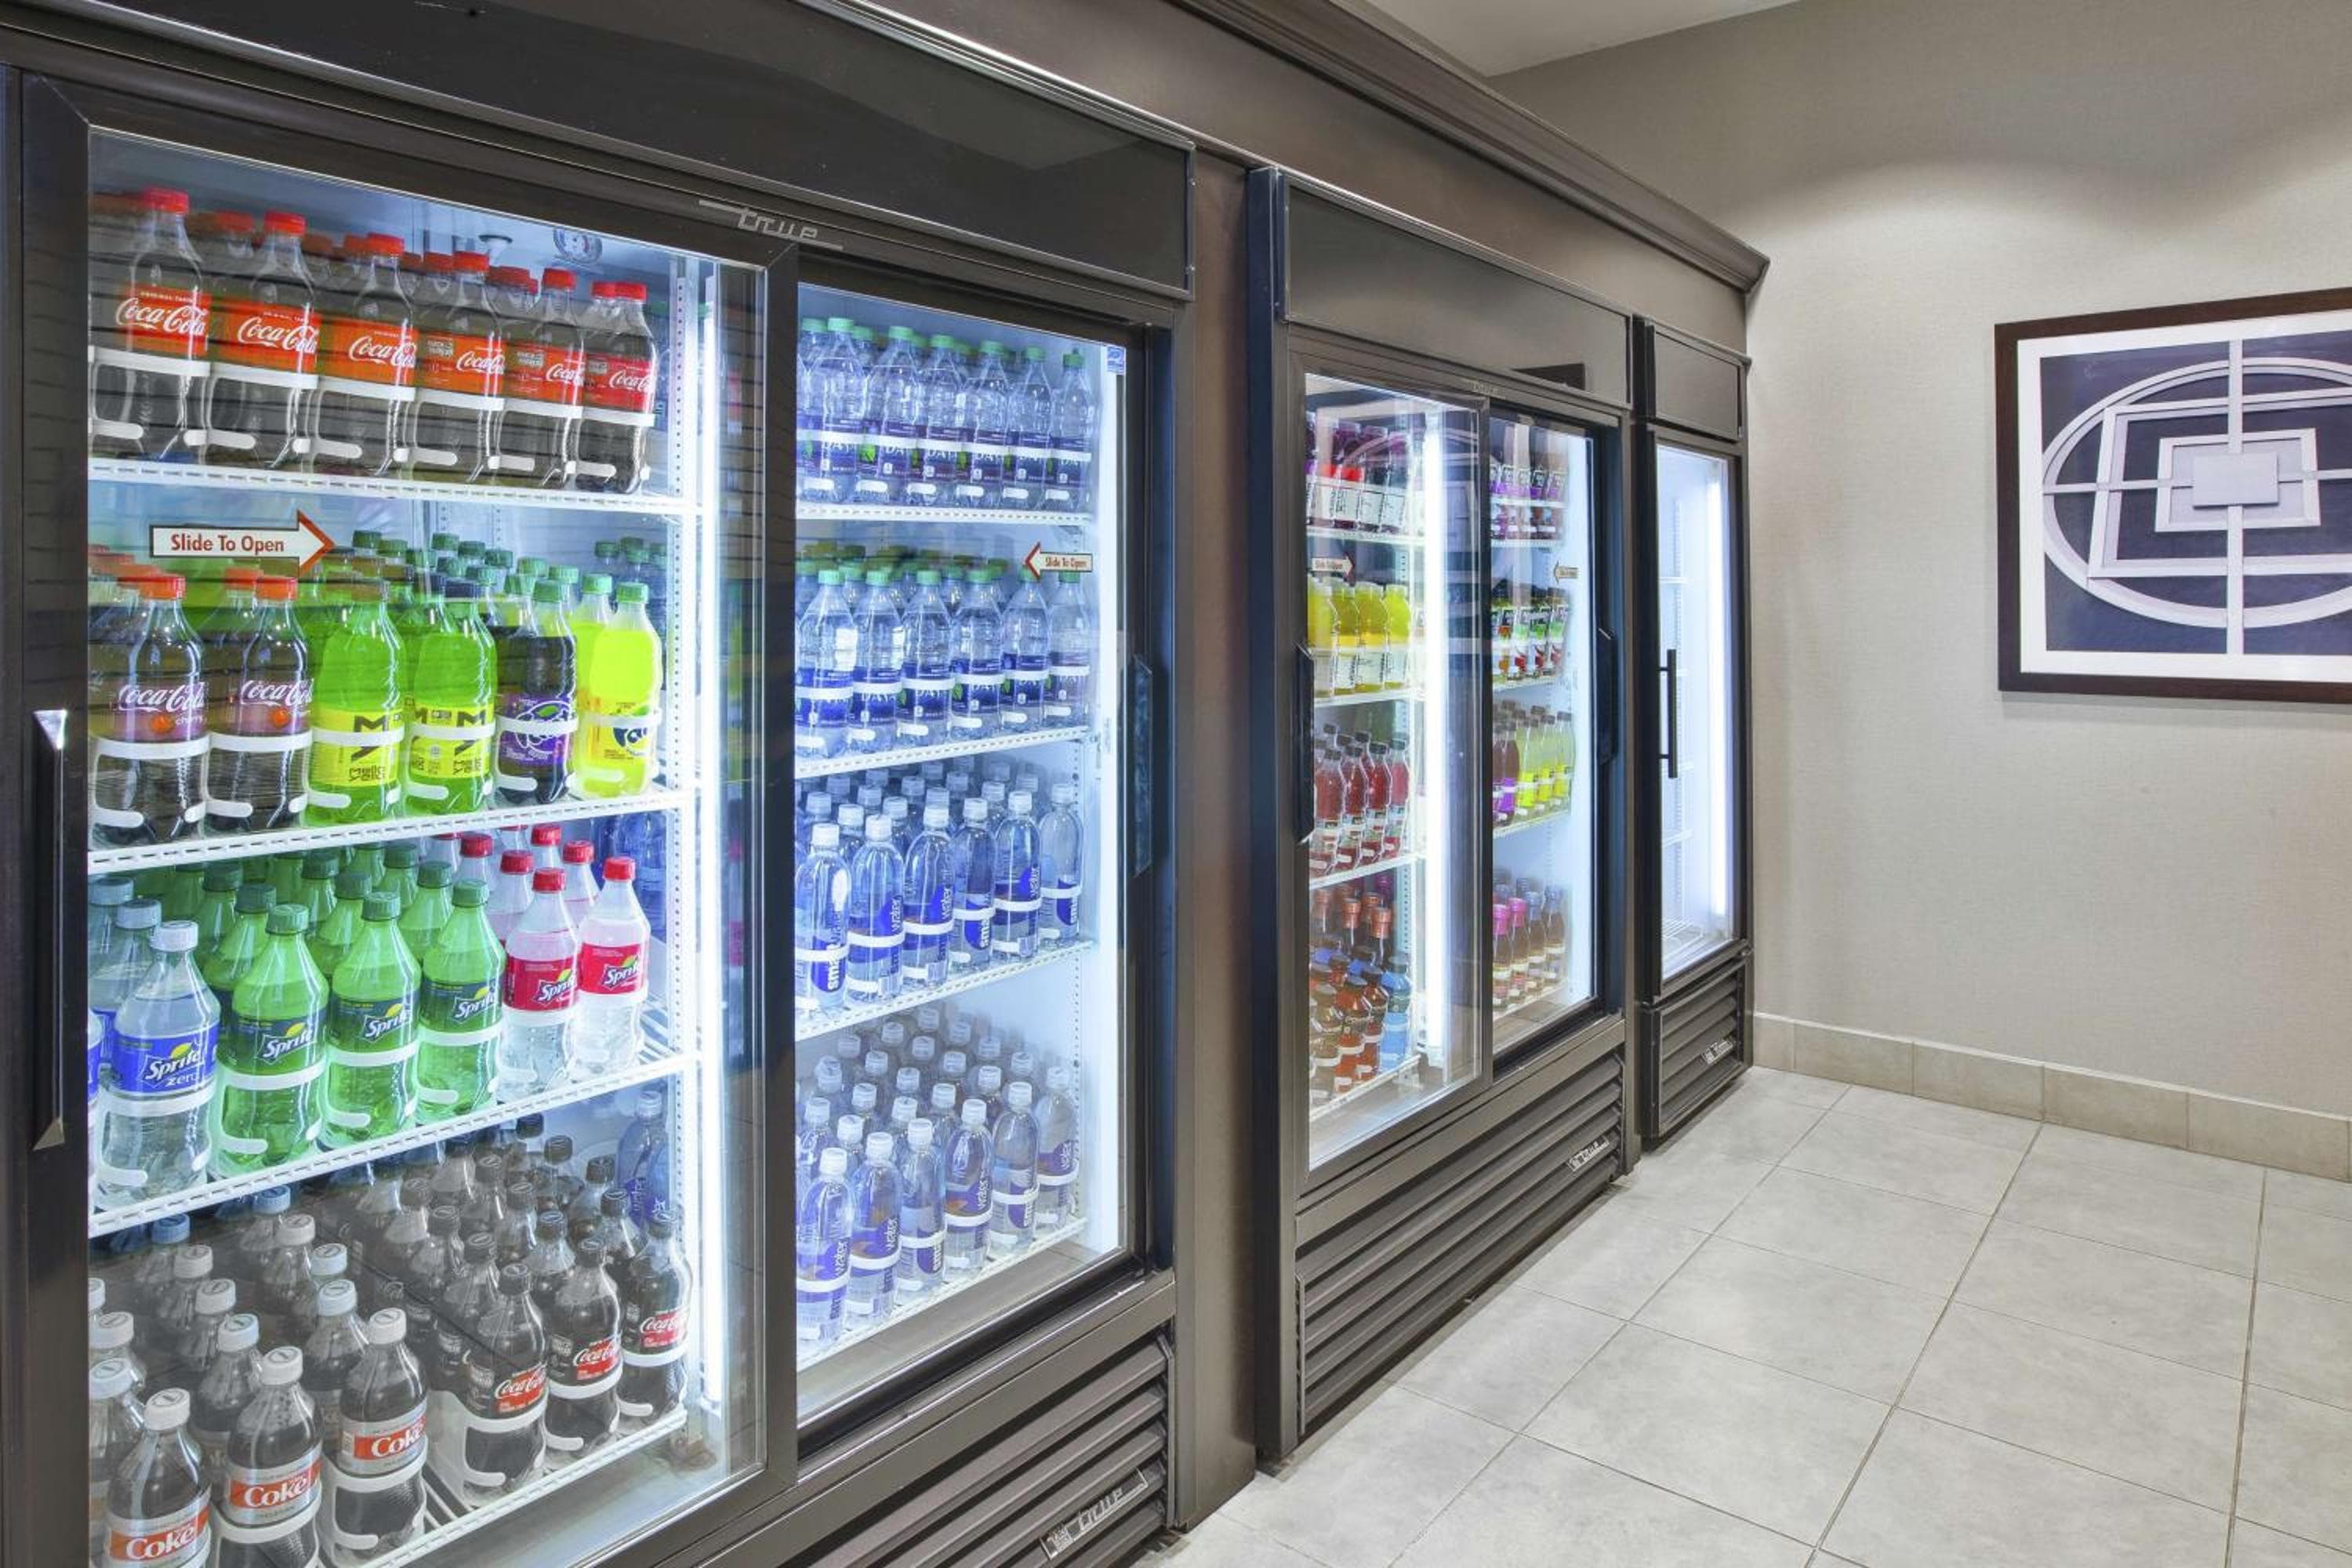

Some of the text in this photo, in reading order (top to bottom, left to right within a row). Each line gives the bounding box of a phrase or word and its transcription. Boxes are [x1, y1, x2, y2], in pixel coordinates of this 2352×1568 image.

[115, 296, 209, 337] Coca-Cola
[237, 315, 320, 354] Coca-Cola
[170, 533, 285, 555] Slide To Open
[145, 1040, 205, 1081] Sprite
[371, 1421, 427, 1459] Coke
[243, 1475, 309, 1509] Coke
[125, 1524, 196, 1561] Coke
